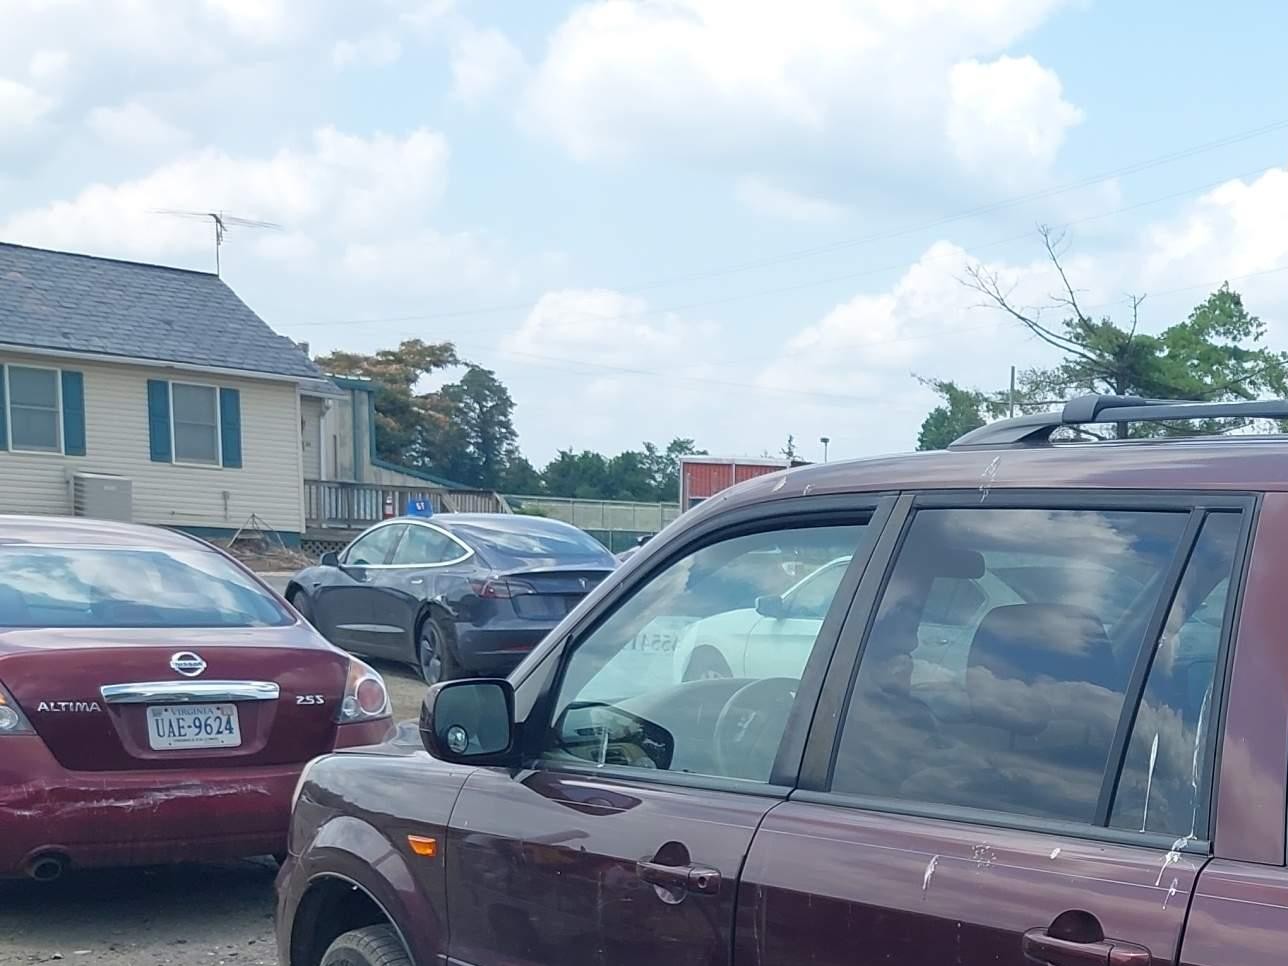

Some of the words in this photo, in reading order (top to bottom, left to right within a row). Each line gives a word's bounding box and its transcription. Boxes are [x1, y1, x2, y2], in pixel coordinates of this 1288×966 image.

[37, 701, 102, 712] ALTIMA
[171, 706, 215, 716] VIRGINIA
[154, 714, 235, 738] UAE-9624
